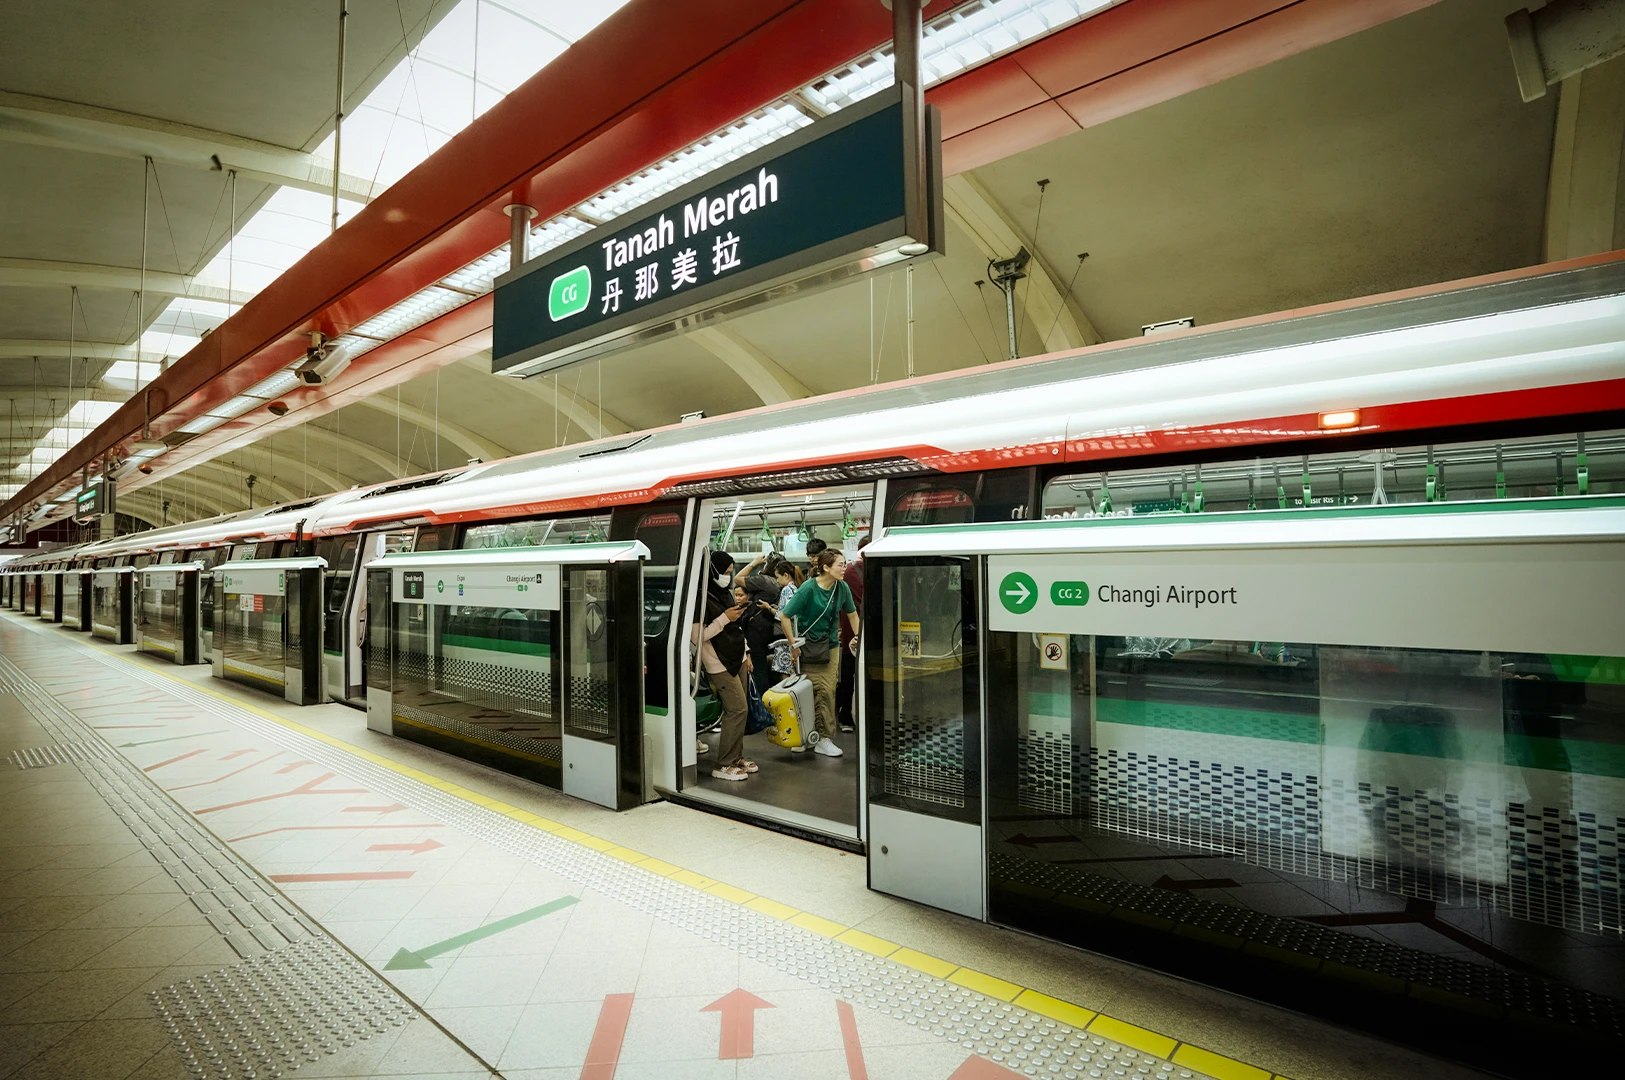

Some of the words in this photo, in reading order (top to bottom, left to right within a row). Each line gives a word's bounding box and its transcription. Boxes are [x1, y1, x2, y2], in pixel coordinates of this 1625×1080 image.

[602, 213, 674, 271] Tanah
[683, 167, 778, 238] Merah
[601, 231, 741, 315] 丹那美拉
[562, 283, 577, 304] CG
[520, 575, 535, 584] Airport
[1058, 588, 1074, 599] CG
[1075, 588, 1082, 599] 2
[1098, 585, 1160, 608] Changi
[1166, 585, 1238, 608] Airport
